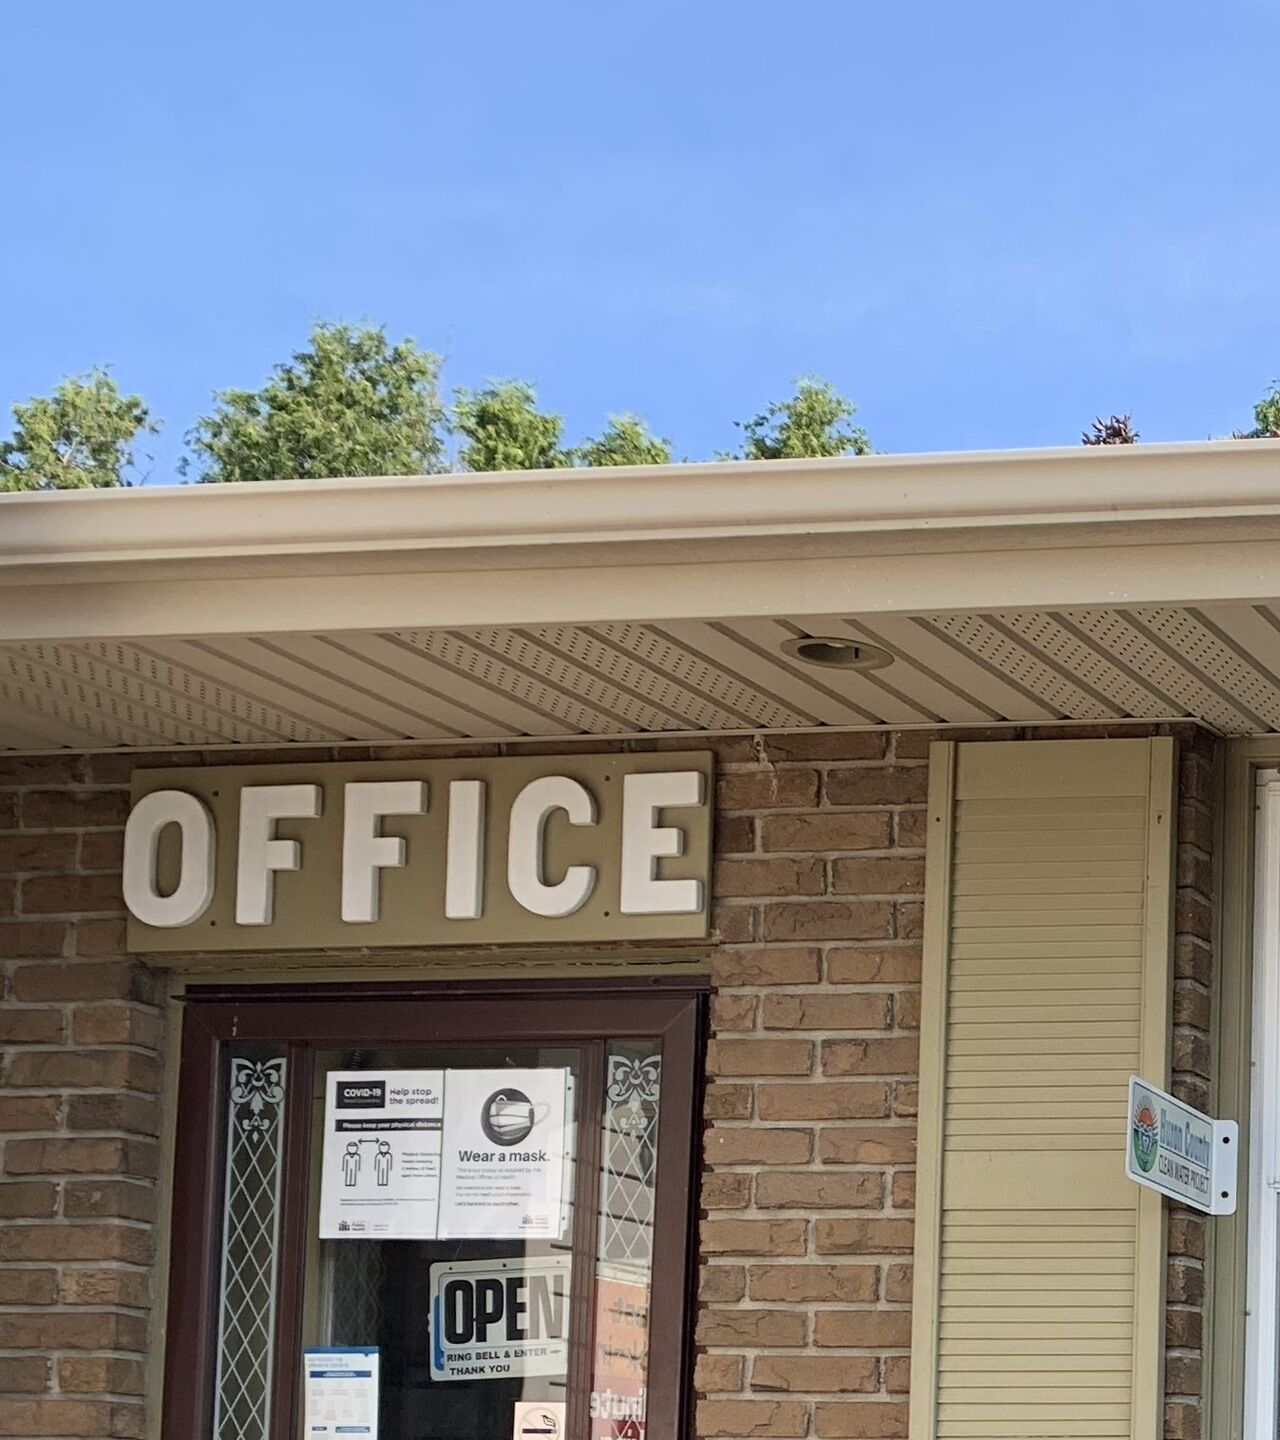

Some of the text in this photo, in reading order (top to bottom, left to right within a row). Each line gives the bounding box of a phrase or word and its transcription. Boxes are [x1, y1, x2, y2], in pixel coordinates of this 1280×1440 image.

[122, 770, 704, 928] OFFICE
[343, 1088, 382, 1097] COVID-19
[389, 1088, 432, 1097] Help stop
[389, 1097, 403, 1105] the
[405, 1097, 439, 1105] spread!
[458, 1149, 551, 1162] Wear a mask.
[444, 1274, 564, 1345] OPEN
[447, 1348, 547, 1362] RING BELL & ENTER
[450, 1365, 510, 1375] THANK YOU
